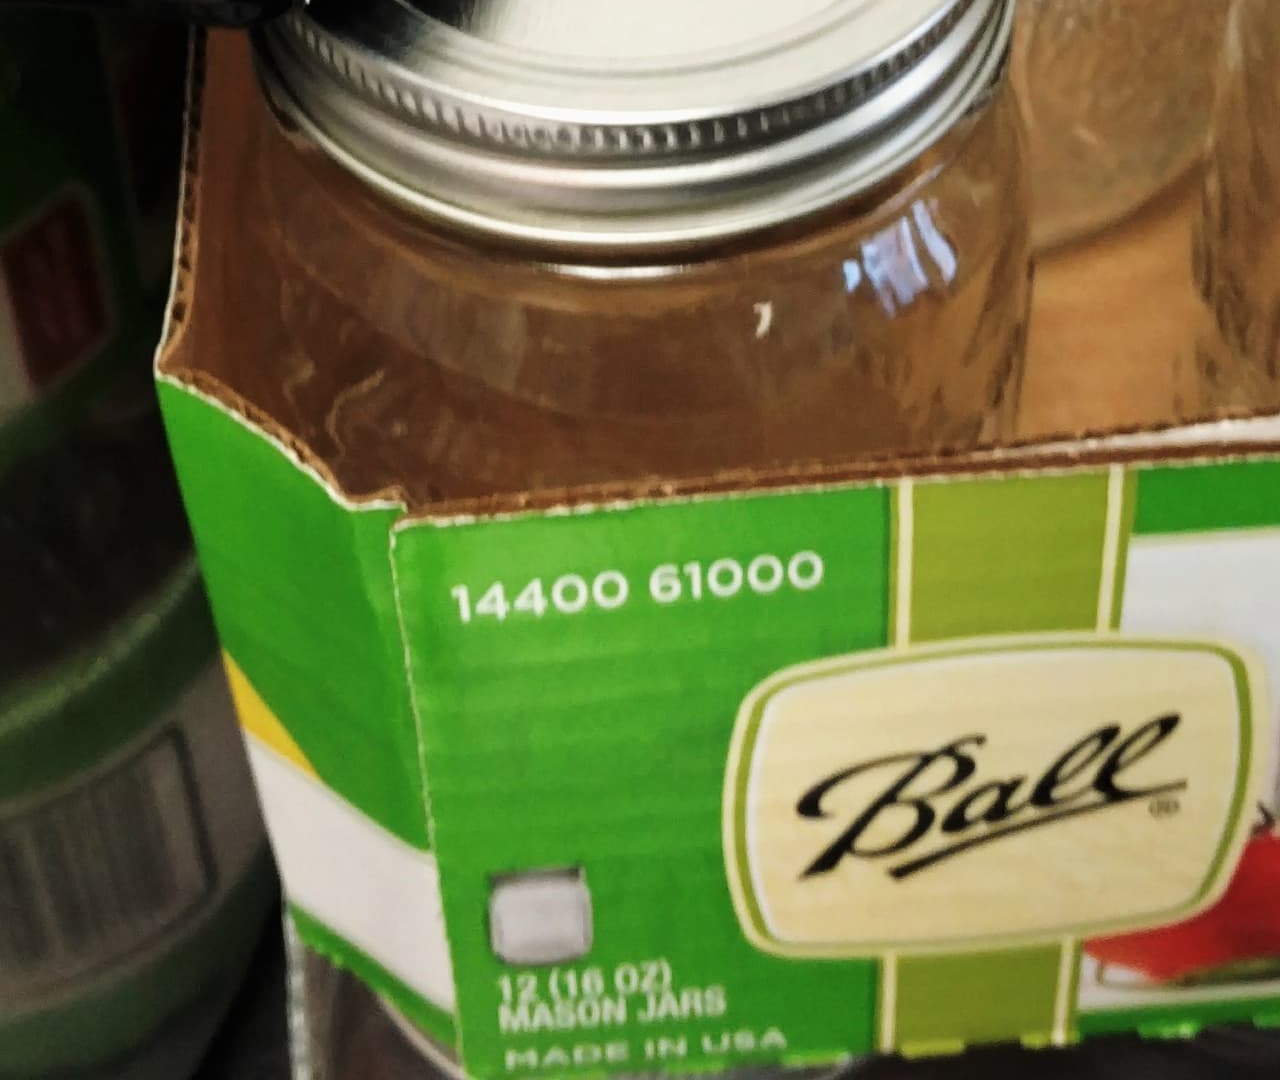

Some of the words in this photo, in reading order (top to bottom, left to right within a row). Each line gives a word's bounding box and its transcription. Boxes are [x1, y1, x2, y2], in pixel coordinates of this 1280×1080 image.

[451, 567, 629, 623] 14400
[649, 551, 825, 603] 61000
[796, 713, 1187, 882] Ball
[498, 973, 538, 1004] 12
[548, 967, 605, 1003] (16
[614, 958, 672, 997] OZ)
[498, 996, 627, 1034] MASON
[637, 985, 727, 1024] JARS
[504, 1040, 629, 1071] MADE
[644, 1035, 688, 1060] IN
[701, 1025, 788, 1055] USA
